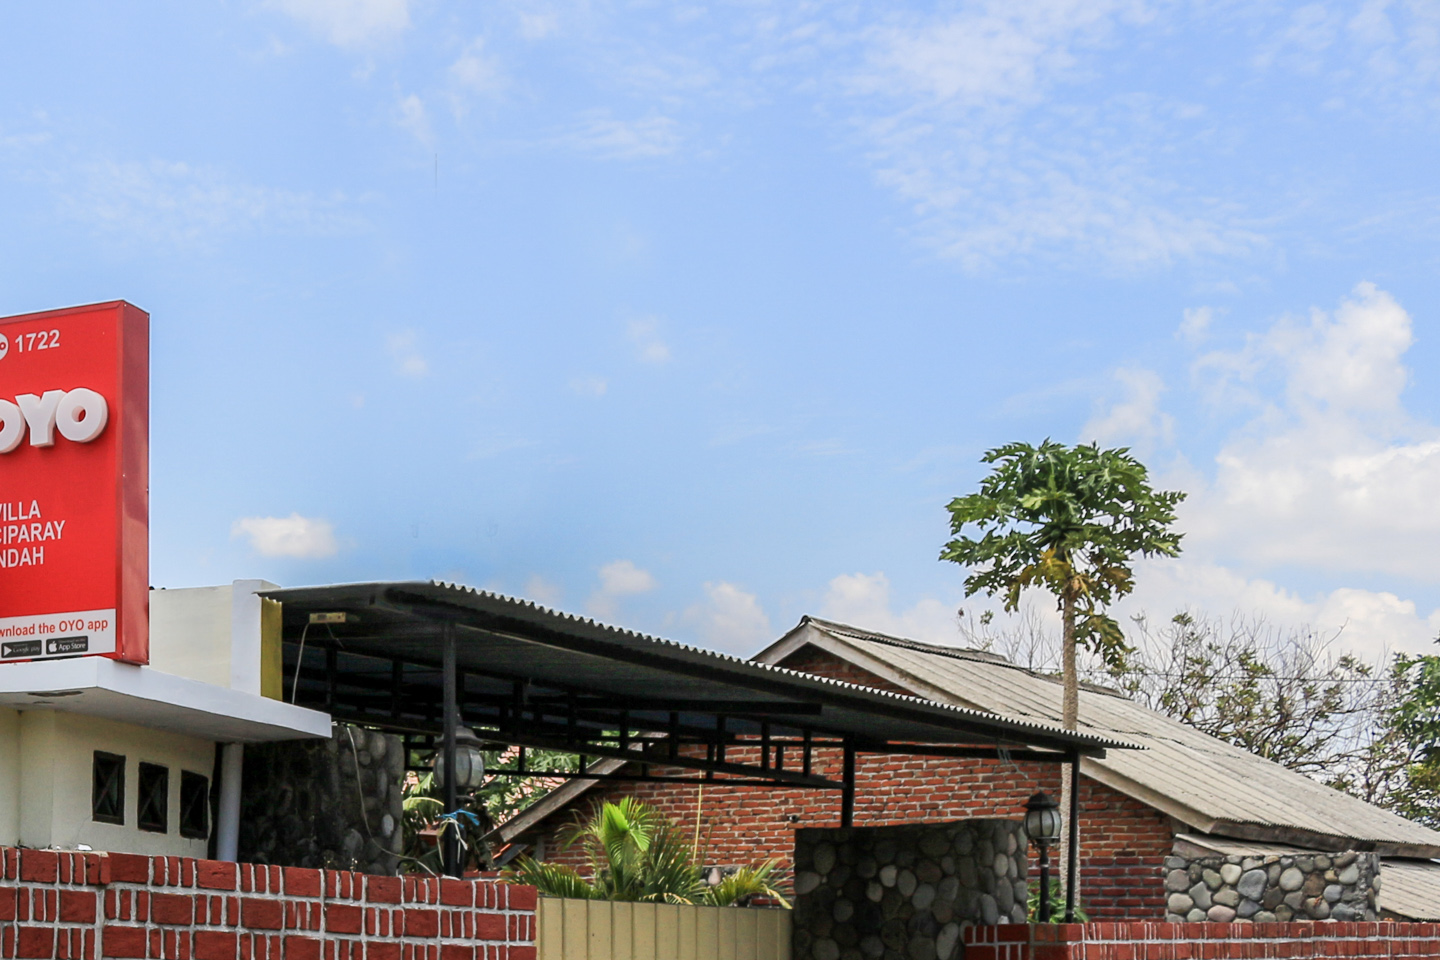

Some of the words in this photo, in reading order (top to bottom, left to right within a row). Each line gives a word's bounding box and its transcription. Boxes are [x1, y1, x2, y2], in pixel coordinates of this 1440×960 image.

[15, 329, 60, 353] 1722
[38, 622, 56, 634] the
[59, 619, 85, 632] OYO
[87, 620, 108, 632] app
[58, 643, 71, 652] App
[71, 642, 86, 650] Store
